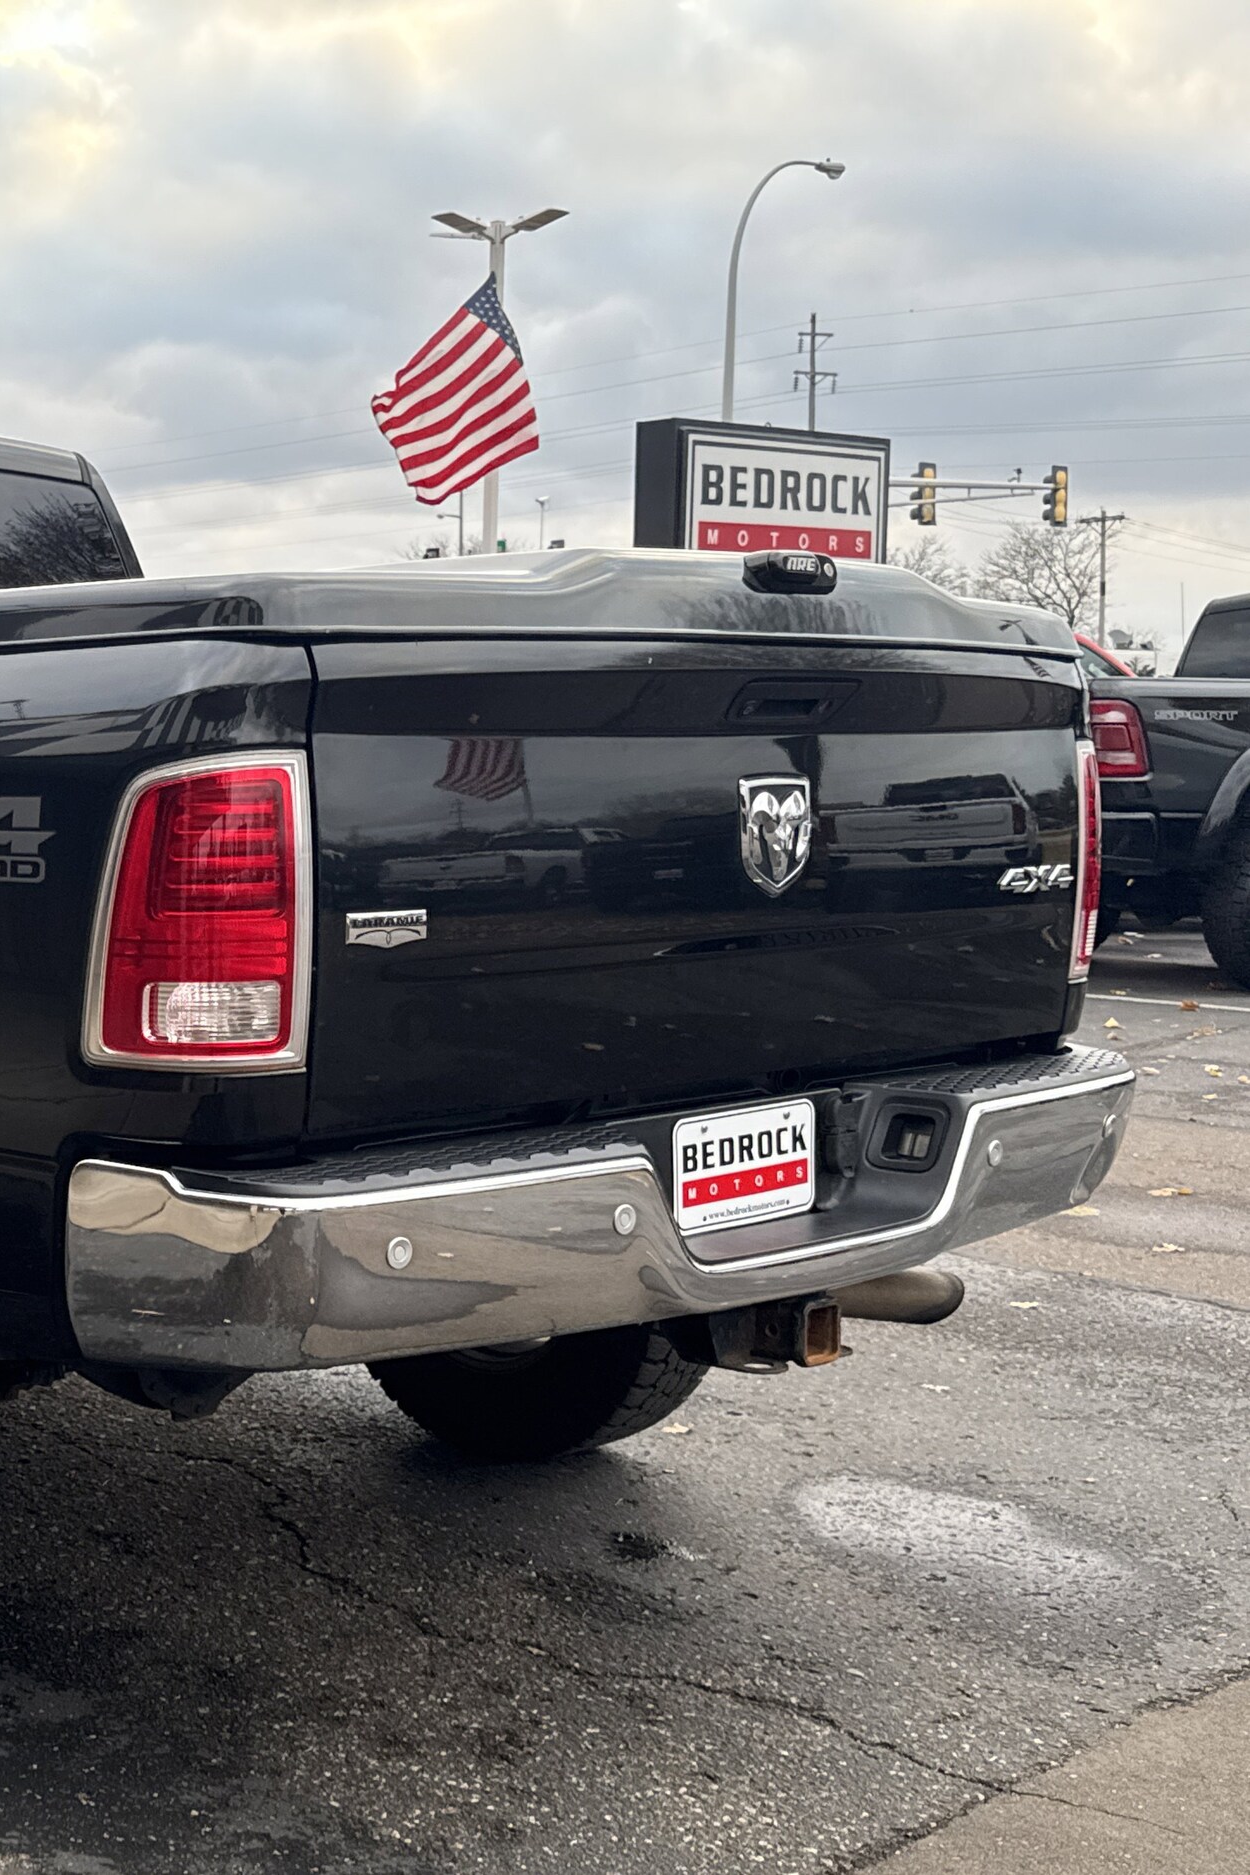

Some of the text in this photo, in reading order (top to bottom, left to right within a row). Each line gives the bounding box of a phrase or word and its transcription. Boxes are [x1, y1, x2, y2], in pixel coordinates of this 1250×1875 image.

[700, 463, 872, 516] BEDROCK
[706, 527, 865, 553] MOTORS
[1154, 709, 1238, 720] SPORT
[682, 1124, 807, 1174] BEDROCK
[687, 1166, 804, 1200] MOTORS
